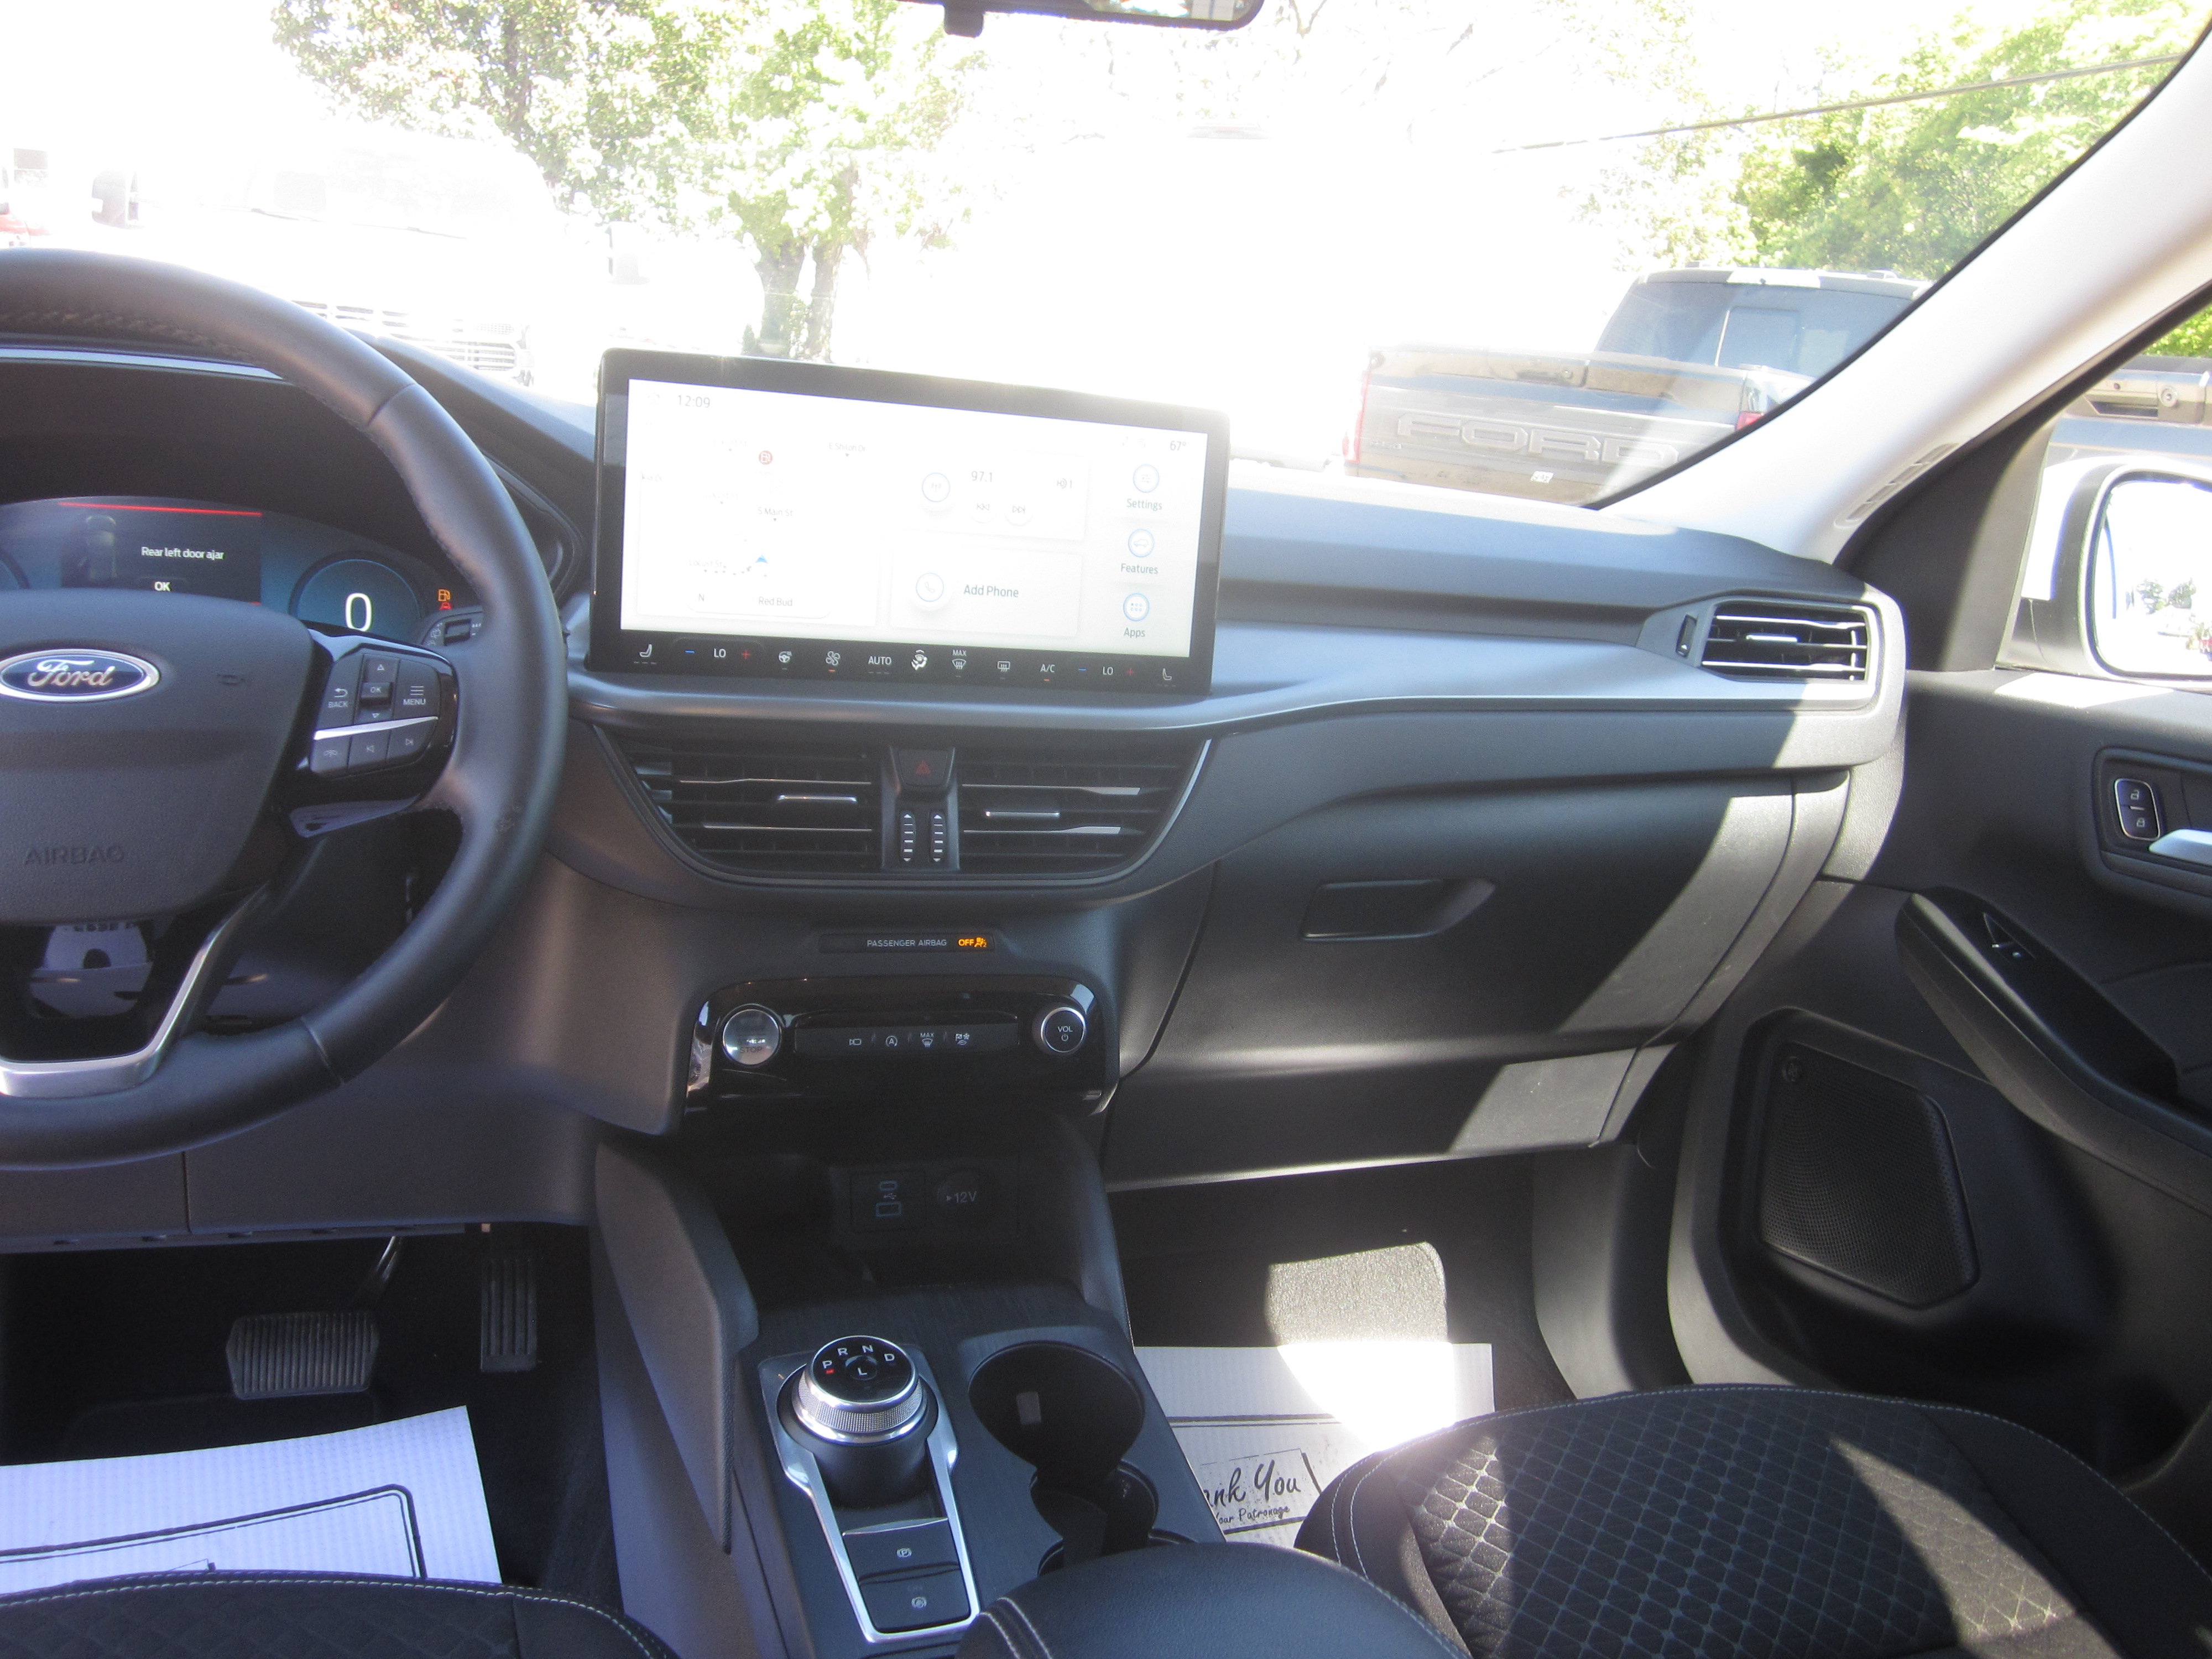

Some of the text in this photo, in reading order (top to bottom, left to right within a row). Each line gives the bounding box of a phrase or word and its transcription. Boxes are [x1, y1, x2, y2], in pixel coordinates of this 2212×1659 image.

[677, 395, 711, 408] 12:09
[1397, 413, 1679, 465] FORD
[1170, 440, 1187, 451] 67°
[971, 471, 993, 482] 97.1
[1126, 498, 1162, 511] Settings
[758, 507, 762, 515] S
[764, 508, 782, 516] Main
[141, 546, 224, 560] Rear left door ajar
[1120, 563, 1159, 575] Features
[154, 581, 171, 592] OK
[963, 585, 1019, 598] Add Phone
[698, 593, 705, 602] N
[759, 596, 792, 607] Red Bud
[345, 592, 373, 632] 0
[1123, 627, 1146, 638] Apps
[714, 648, 726, 659] LO
[868, 656, 892, 666] AUTO
[28, 659, 116, 687] Ford
[1040, 664, 1055, 673] A/C
[1102, 667, 1114, 676] LO
[23, 846, 125, 866] AIRBAG
[954, 1190, 977, 1203] 12V
[822, 1344, 895, 1369] P R N D
[857, 1367, 868, 1376] L
[1254, 1459, 1301, 1501] You
[1239, 1505, 1290, 1521] Patronage
